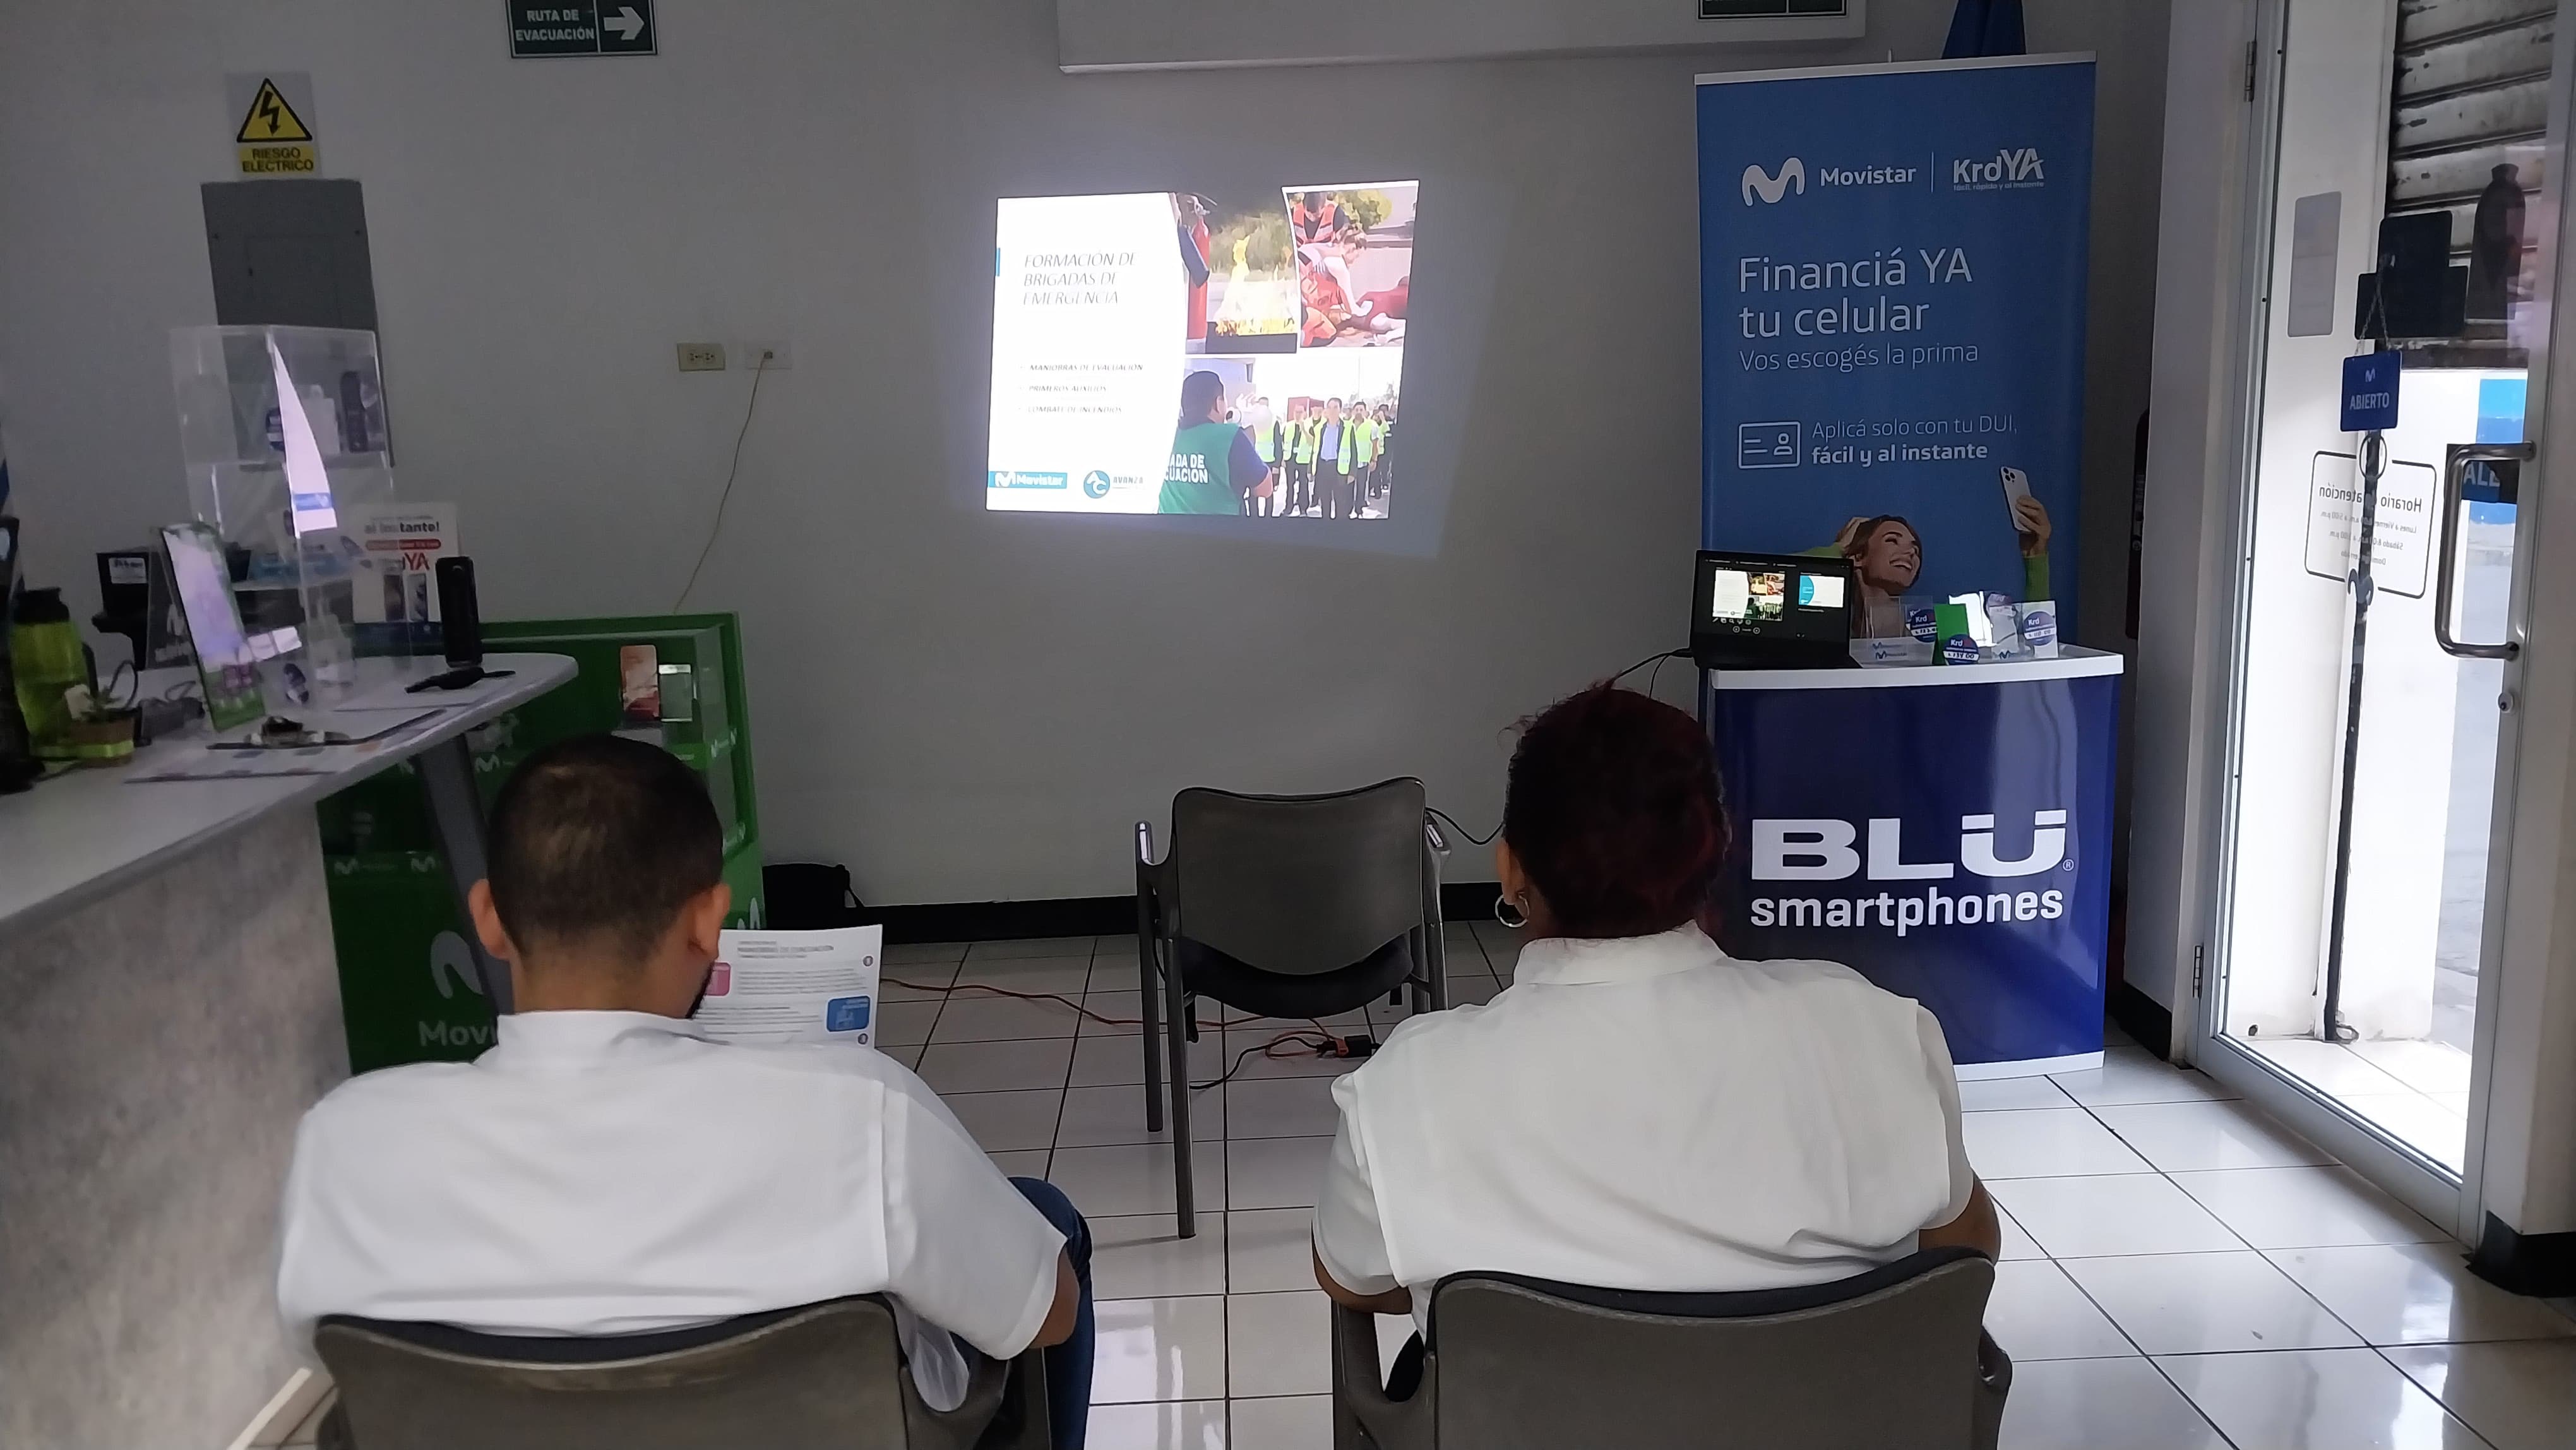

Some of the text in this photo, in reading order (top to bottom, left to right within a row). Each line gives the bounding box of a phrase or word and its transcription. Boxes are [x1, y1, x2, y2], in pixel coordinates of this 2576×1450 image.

[526, 9, 580, 21] RUTA DE
[515, 27, 595, 41] EVACUACIÓN
[252, 146, 301, 159] RIESGO
[242, 158, 314, 172] ELECTRICO
[1952, 148, 2044, 184] KrdYA
[1820, 165, 1917, 188] Movistar
[1025, 251, 1137, 268] FORMACIÓN DE
[1739, 246, 1973, 292] Financiá YA
[1023, 272, 1120, 287] BRIGADAS DE
[1023, 291, 1118, 305] EMERGENCIA
[1739, 295, 1930, 339] tu celular
[1739, 342, 1979, 373] Vos escogés la prima
[2349, 392, 2390, 410] ABIERTO
[1811, 414, 2018, 443] Aplicá solo con tu DUI,
[1170, 453, 1205, 469] ADA DE
[1811, 443, 1988, 468] fácil y al instante
[1016, 474, 1064, 486] Movistar
[1113, 476, 1144, 484] AVANZA
[1750, 886, 2063, 937] smartphones
